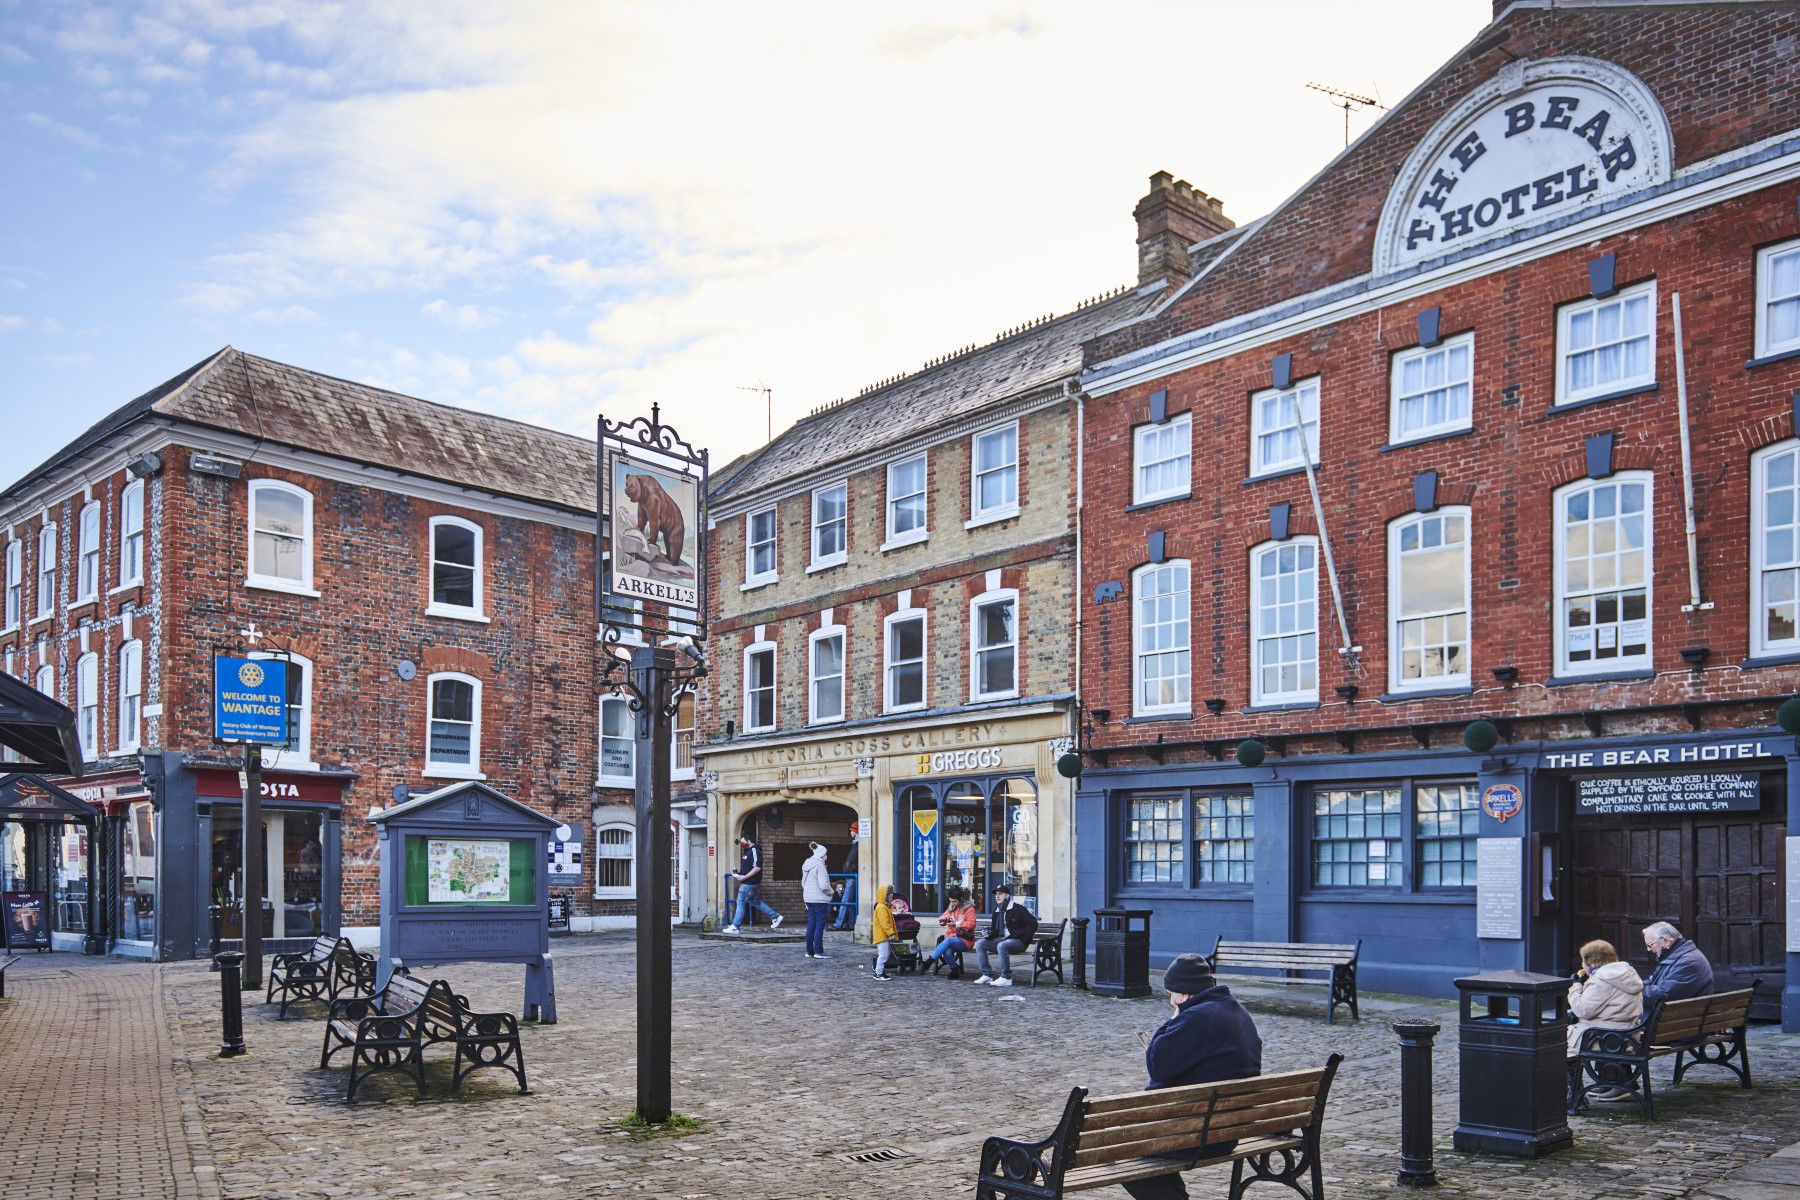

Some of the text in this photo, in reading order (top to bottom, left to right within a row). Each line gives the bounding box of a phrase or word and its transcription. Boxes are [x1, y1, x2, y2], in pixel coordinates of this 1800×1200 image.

[1407, 96, 1636, 250] THE BEAR
[1440, 164, 1598, 242] HOTEL
[222, 691, 281, 703] WELCOME TO
[222, 702, 281, 716] WANTAGE
[751, 723, 994, 766] VICTORIA CROSS GALLERY
[932, 747, 1002, 772] GREGGS
[1546, 743, 1771, 769] THE BEAR HOTEL
[1580, 780, 1596, 788] OUR
[1597, 779, 1622, 787] COFFEE
[1633, 777, 1667, 786] ETHICALLY
[1671, 775, 1701, 784] SOURCED
[1711, 774, 1742, 783] LOCALLY
[1581, 780, 1758, 795] SUPPLIED BY THE OXFORD COFFEE COMPANY
[82, 787, 101, 801] COSTA
[261, 783, 299, 797] OSTA
[1581, 794, 1643, 806] COMPLIMENTARY
[1648, 793, 1668, 802] CAKE
[1684, 791, 1714, 800] COOKIE
[1716, 790, 1736, 798] WITH
[1739, 790, 1754, 798] ALL
[1596, 801, 1729, 813] HOT DRINKS IN THE BAR UNTIL 5PM
[1013, 809, 1030, 824] GO
